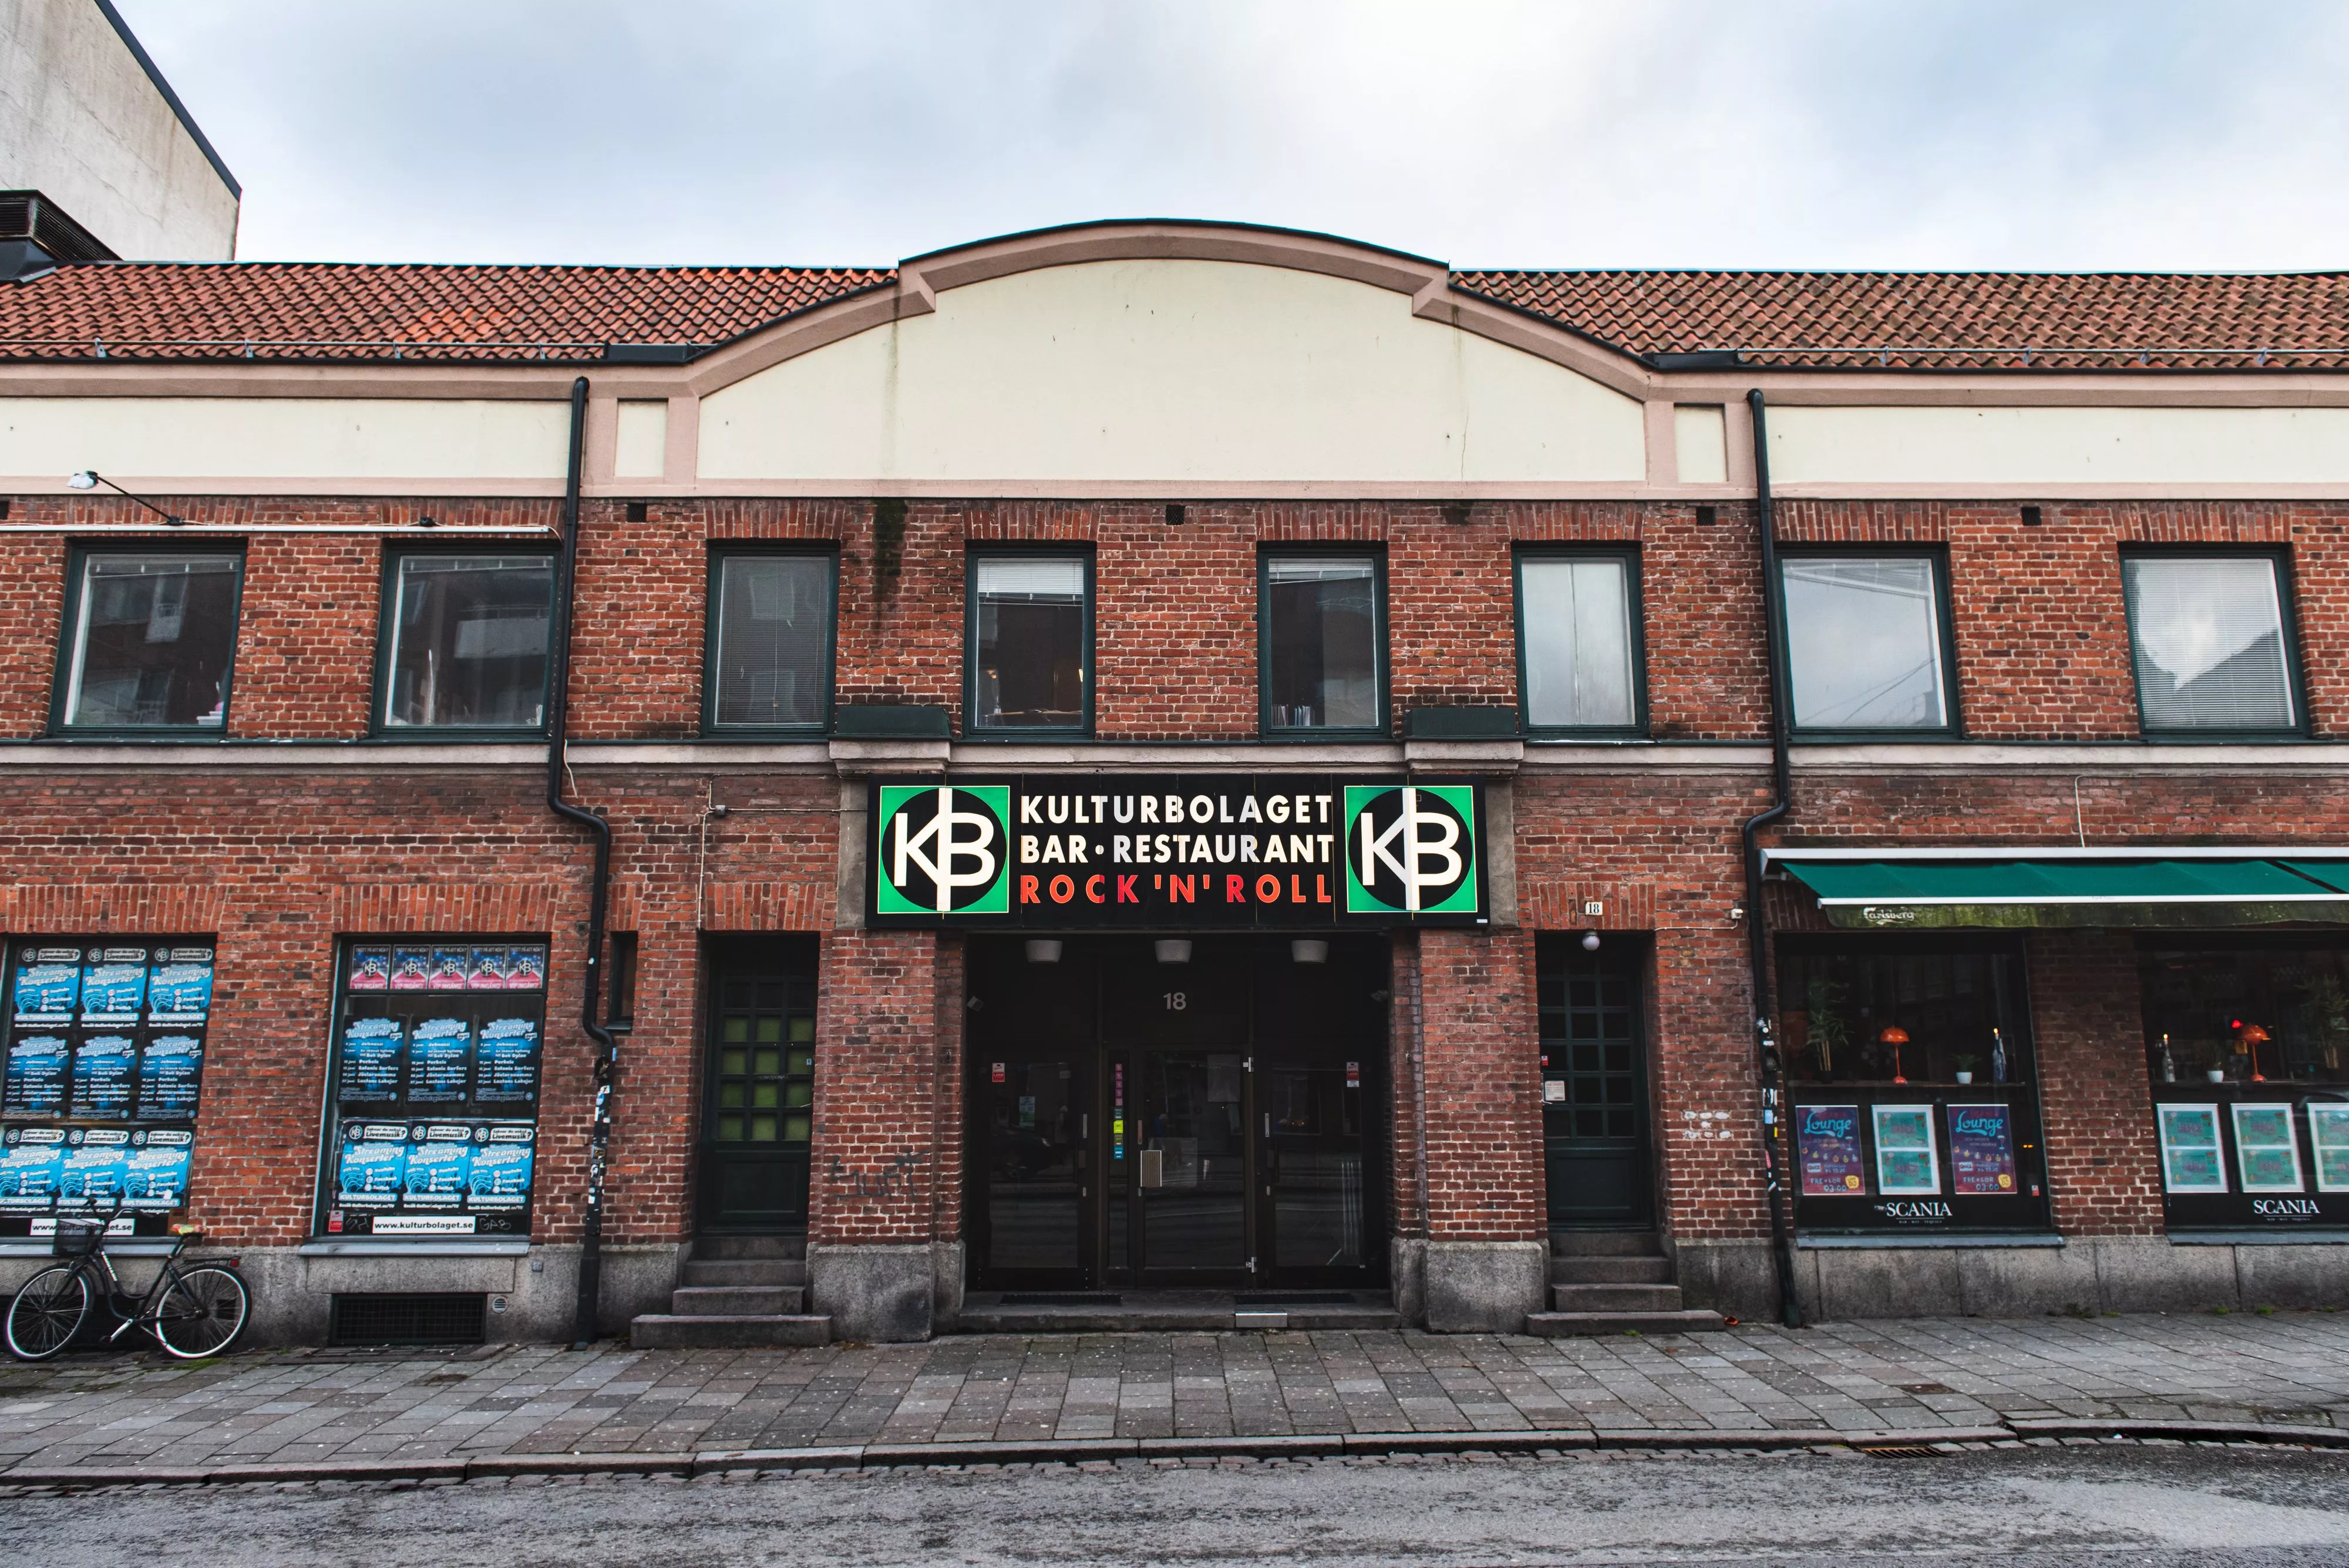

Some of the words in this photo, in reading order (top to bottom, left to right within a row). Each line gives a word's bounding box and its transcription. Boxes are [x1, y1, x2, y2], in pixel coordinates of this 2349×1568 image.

[1022, 795, 1332, 823] KULTURBOLAGET
[894, 788, 995, 911] KB
[1021, 835, 1088, 863] BAR
[1114, 834, 1334, 863] RESTAURANT
[1361, 788, 1462, 911] KB
[1021, 874, 1139, 903] ROCK
[1155, 874, 1210, 903] 'N'
[1227, 874, 1331, 903] ROLL
[1589, 903, 1599, 913] 18
[1863, 907, 1914, 925] Carlsberg
[1163, 992, 1186, 1010] 18
[353, 1022, 399, 1032] Streaming
[420, 1022, 466, 1032] Streaming
[487, 1022, 534, 1032] Streaming
[1804, 1112, 1852, 1138] Lounge
[1955, 1111, 2003, 1137] Lounge
[10, 1149, 60, 1160] Streaming
[74, 1150, 124, 1161] Streaming
[137, 1151, 187, 1162] Streaming
[354, 1146, 404, 1157] Streaming
[418, 1146, 467, 1157] Streaming
[481, 1148, 530, 1159] Streaming
[345, 1154, 394, 1165] Konserter
[409, 1154, 457, 1165] Konserter
[472, 1156, 521, 1166] Konserter
[1886, 1202, 1953, 1216] SCANIA
[2253, 1200, 2321, 1214] SCANIA
[375, 1220, 473, 1230] www.kulturbolaget.se
